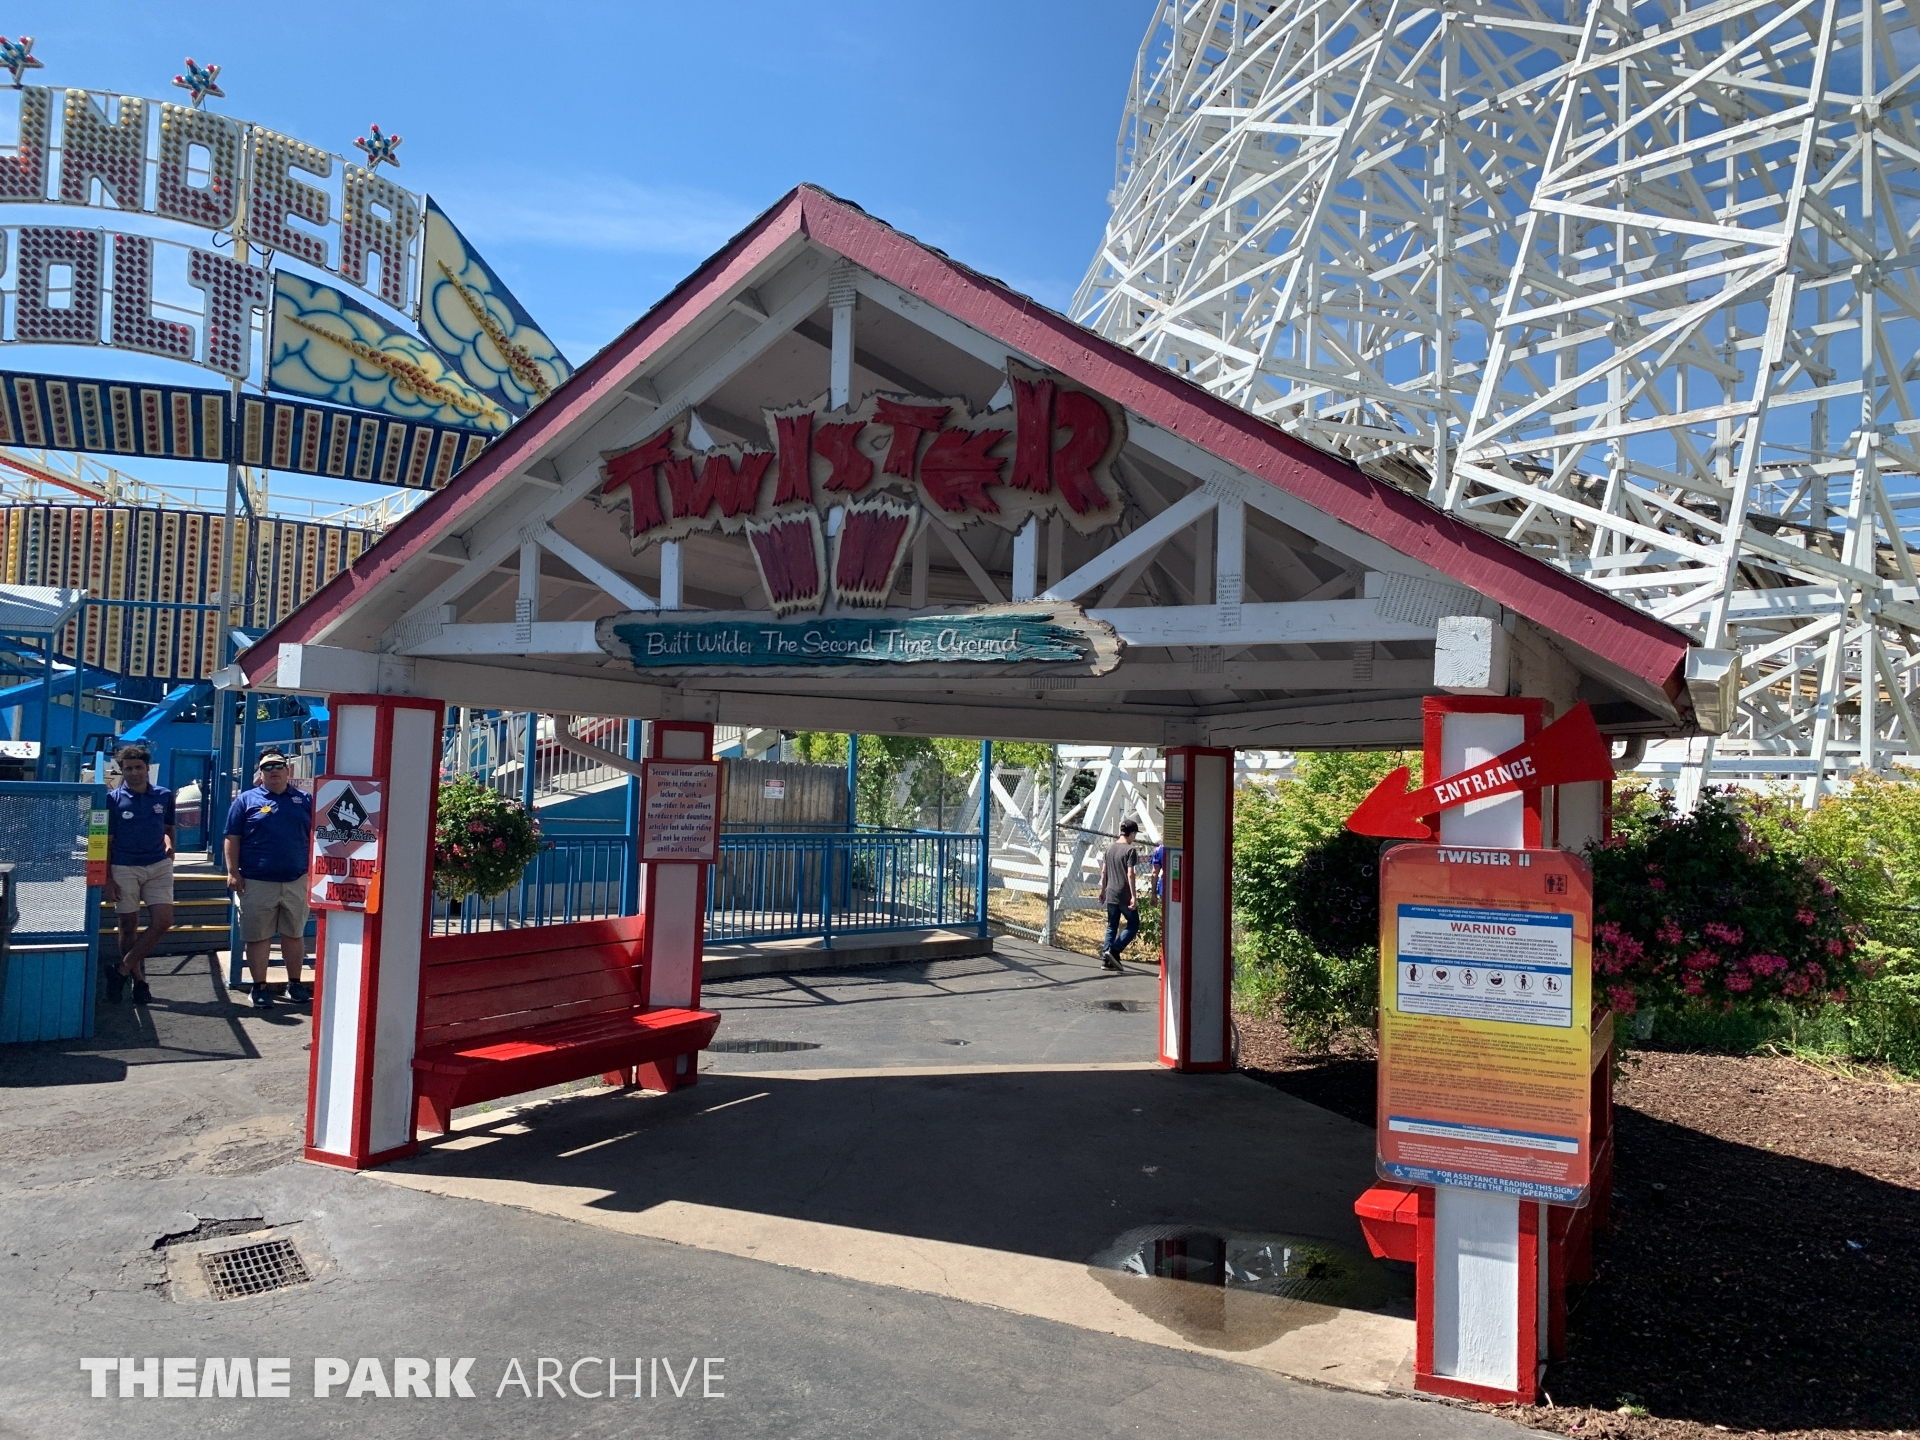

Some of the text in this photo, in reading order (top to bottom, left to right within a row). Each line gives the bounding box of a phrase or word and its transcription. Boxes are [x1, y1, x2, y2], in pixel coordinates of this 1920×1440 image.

[0, 224, 271, 380] OLT
[647, 626, 1020, 656] Built Wilder The Second Time Around
[1434, 756, 1536, 804] ENTRANCE
[316, 826, 376, 842] Rapid Ride
[315, 856, 375, 879] RAPID RIDE
[1437, 850, 1530, 866] TWISTER II
[326, 882, 366, 903] ACCESS
[1451, 922, 1516, 936] WARNING
[1445, 1178, 1472, 1187] PLEASE
[1488, 1184, 1503, 1192] THE
[1504, 1186, 1522, 1194] RIDE
[1523, 1188, 1566, 1201] OPERATOR.
[1453, 1172, 1498, 1185] ASSISTANCE
[1500, 1178, 1533, 1189] READING
[1535, 1184, 1552, 1193] THIS
[1554, 1185, 1575, 1195] SIGN.
